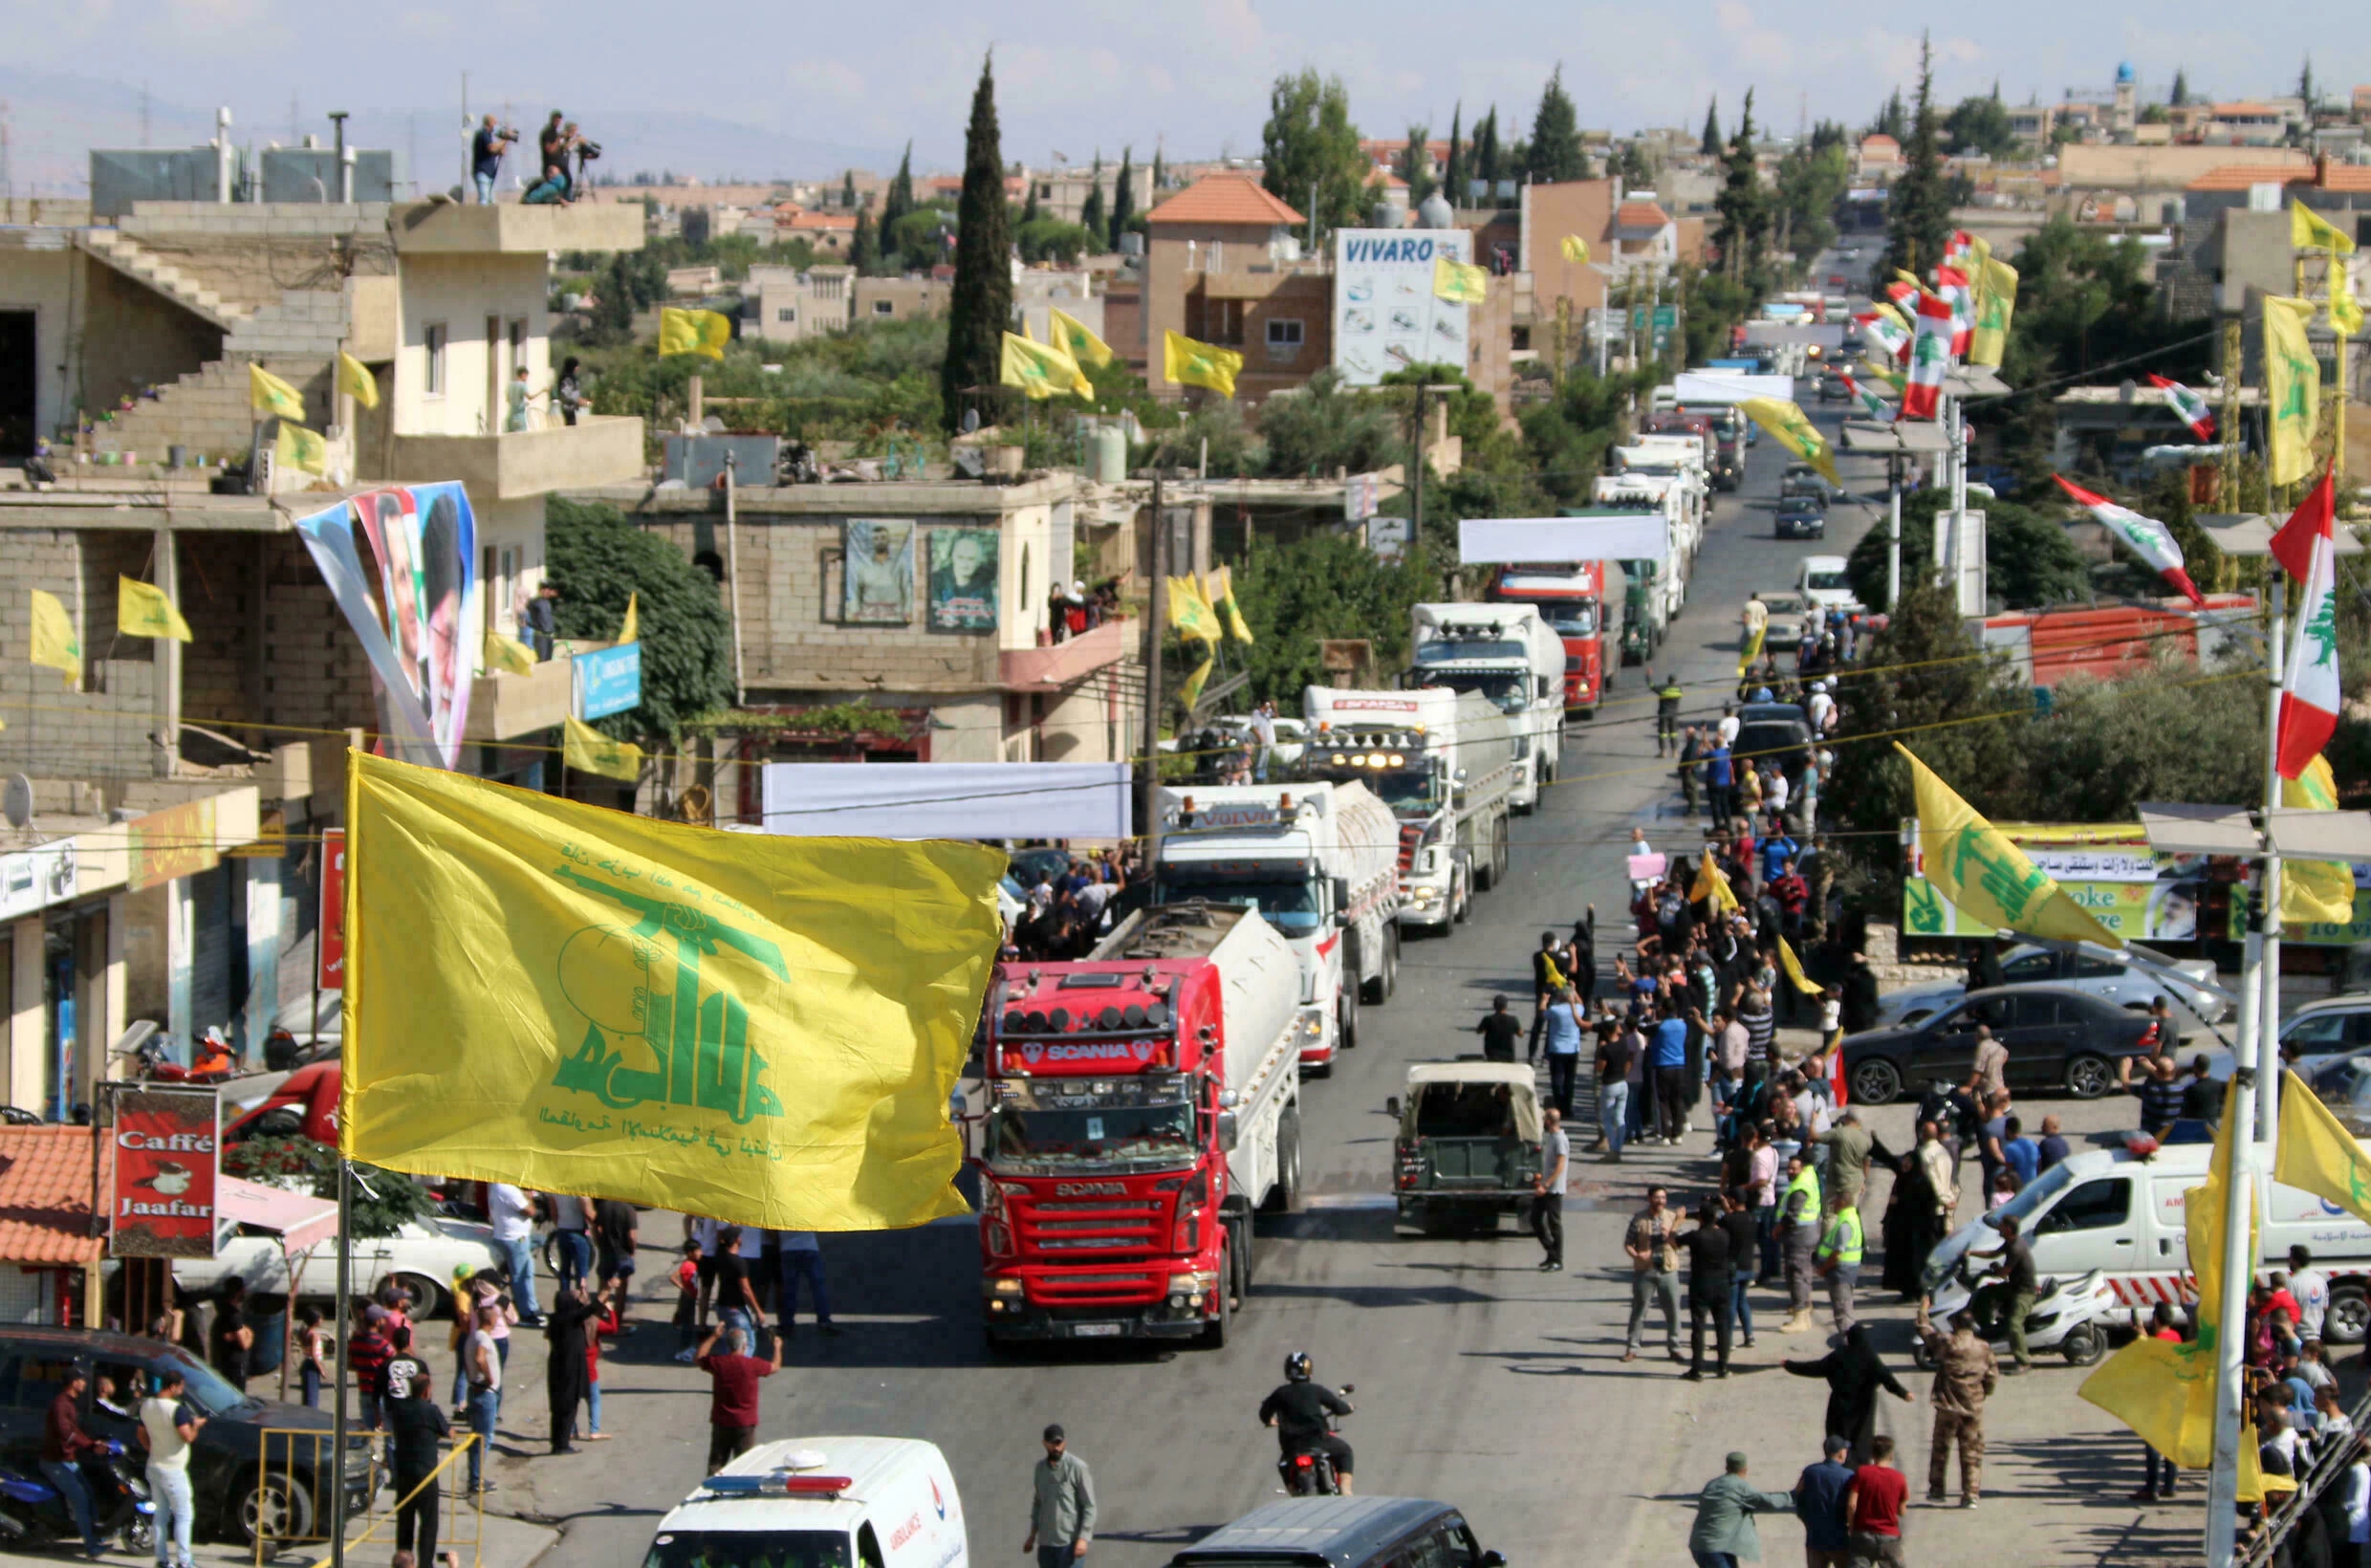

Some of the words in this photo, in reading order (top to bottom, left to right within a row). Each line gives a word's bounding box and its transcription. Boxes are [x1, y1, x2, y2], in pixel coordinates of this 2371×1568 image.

[1347, 238, 1433, 262] VIVARO
[1201, 812, 1273, 825] VOLVO
[2071, 885, 2115, 905] oke
[1048, 1043, 1129, 1061] SCANIA
[119, 1131, 214, 1153] Caffé
[1055, 1182, 1127, 1196] SCANIA
[120, 1197, 212, 1217] Jaafar
